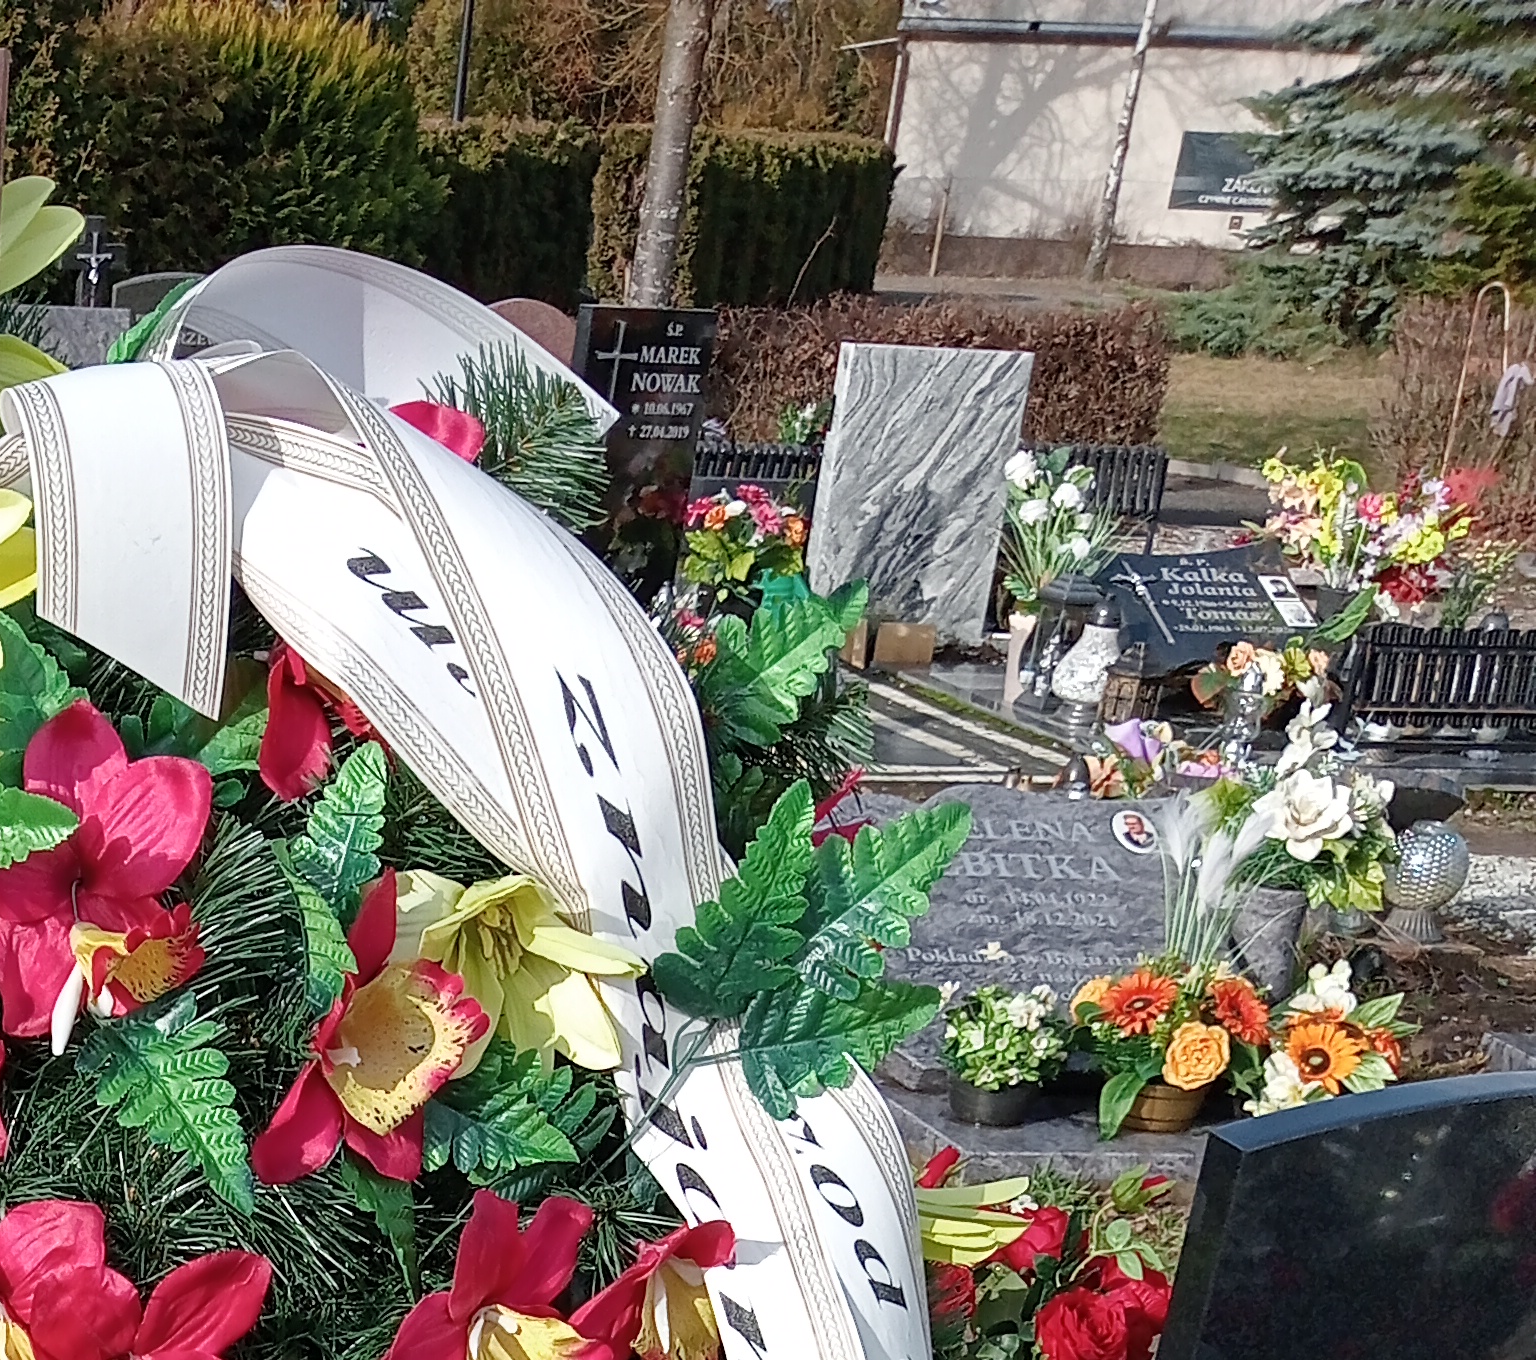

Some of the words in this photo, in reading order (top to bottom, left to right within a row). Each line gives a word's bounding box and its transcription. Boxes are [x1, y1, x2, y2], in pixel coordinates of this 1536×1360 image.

[639, 344, 702, 365] MAREK
[629, 372, 702, 393] NOWAK
[1160, 567, 1249, 584] Kalka
[1167, 583, 1258, 598] Jolanta
